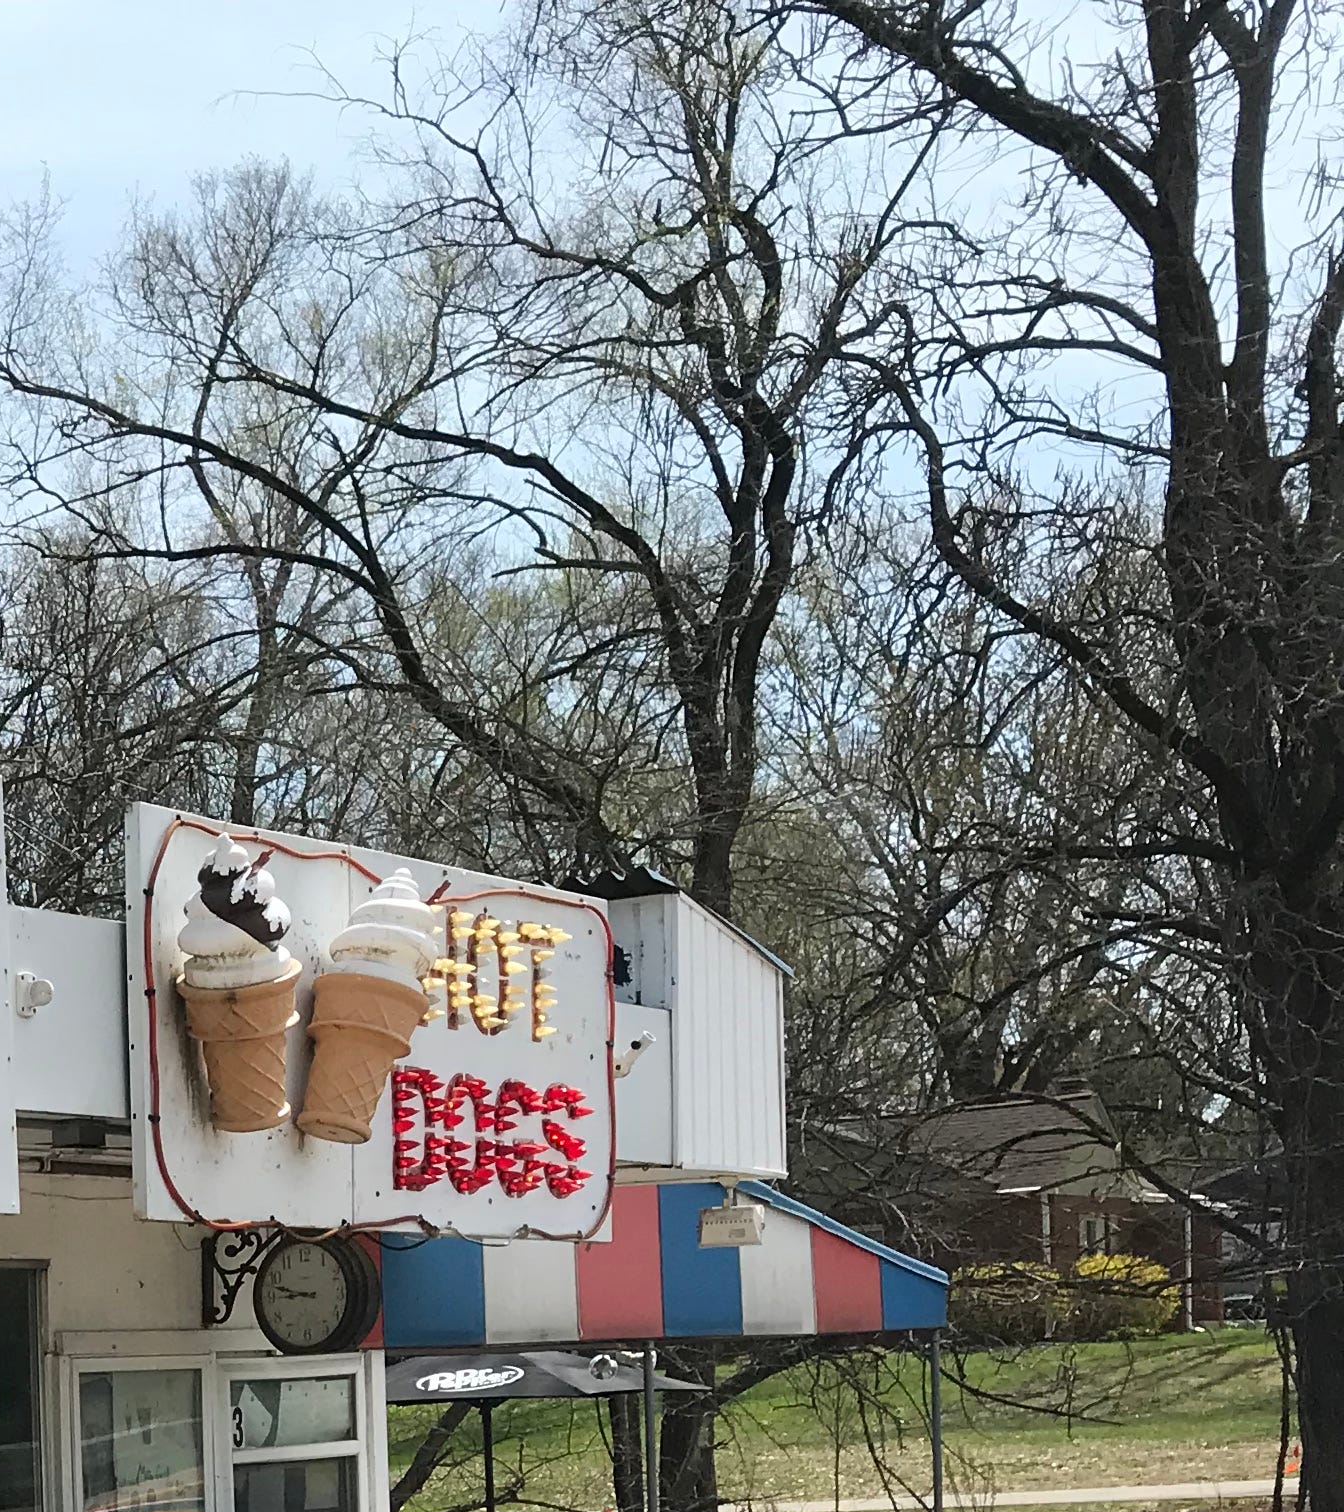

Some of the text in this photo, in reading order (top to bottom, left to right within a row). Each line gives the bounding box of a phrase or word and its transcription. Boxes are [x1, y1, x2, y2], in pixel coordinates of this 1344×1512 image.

[422, 904, 572, 1042] HOT
[392, 1065, 594, 1199] DOGS
[232, 1407, 244, 1447] 3
